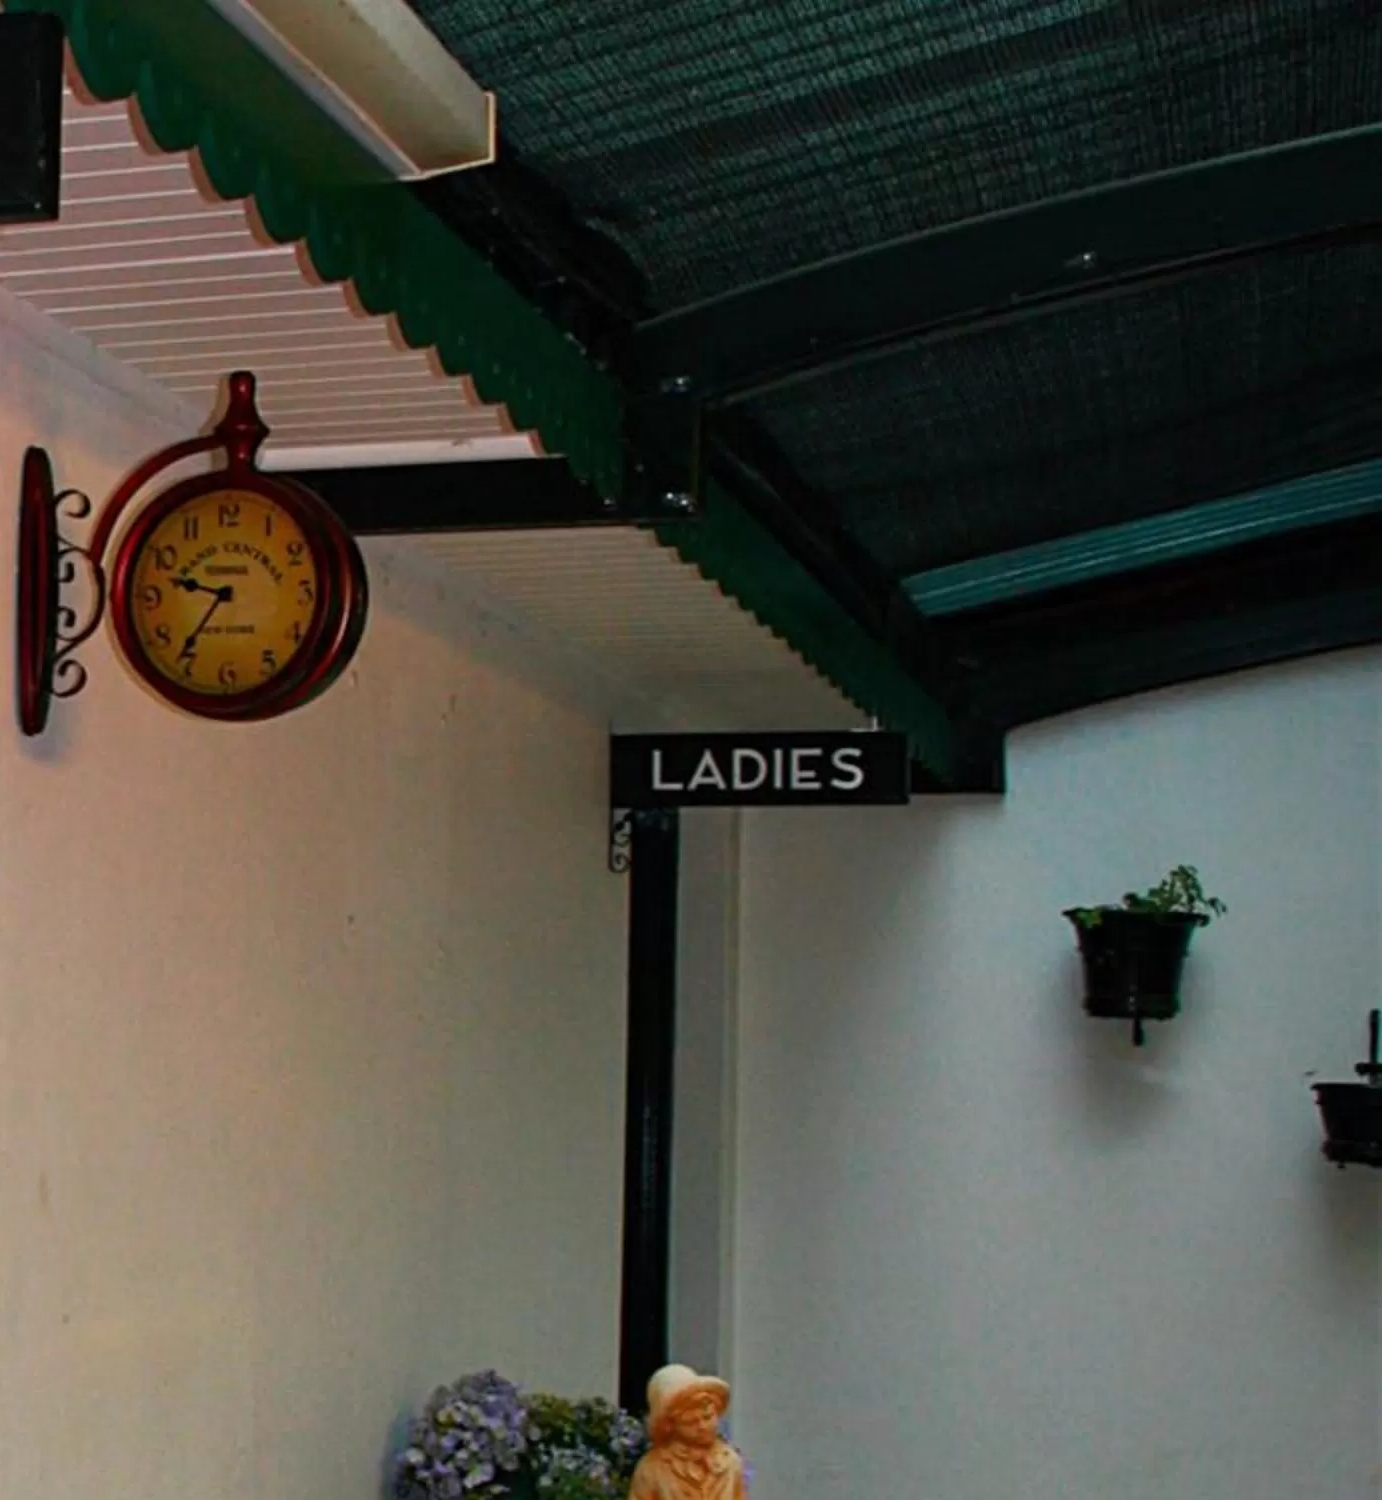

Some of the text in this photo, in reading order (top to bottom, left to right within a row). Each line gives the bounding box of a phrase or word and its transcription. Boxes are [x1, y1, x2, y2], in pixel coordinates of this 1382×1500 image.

[218, 503, 240, 527] 12
[184, 516, 199, 540] 11
[154, 544, 178, 571] 10
[286, 543, 302, 566] 2
[144, 584, 163, 609] 9
[651, 748, 865, 791] LADIES
